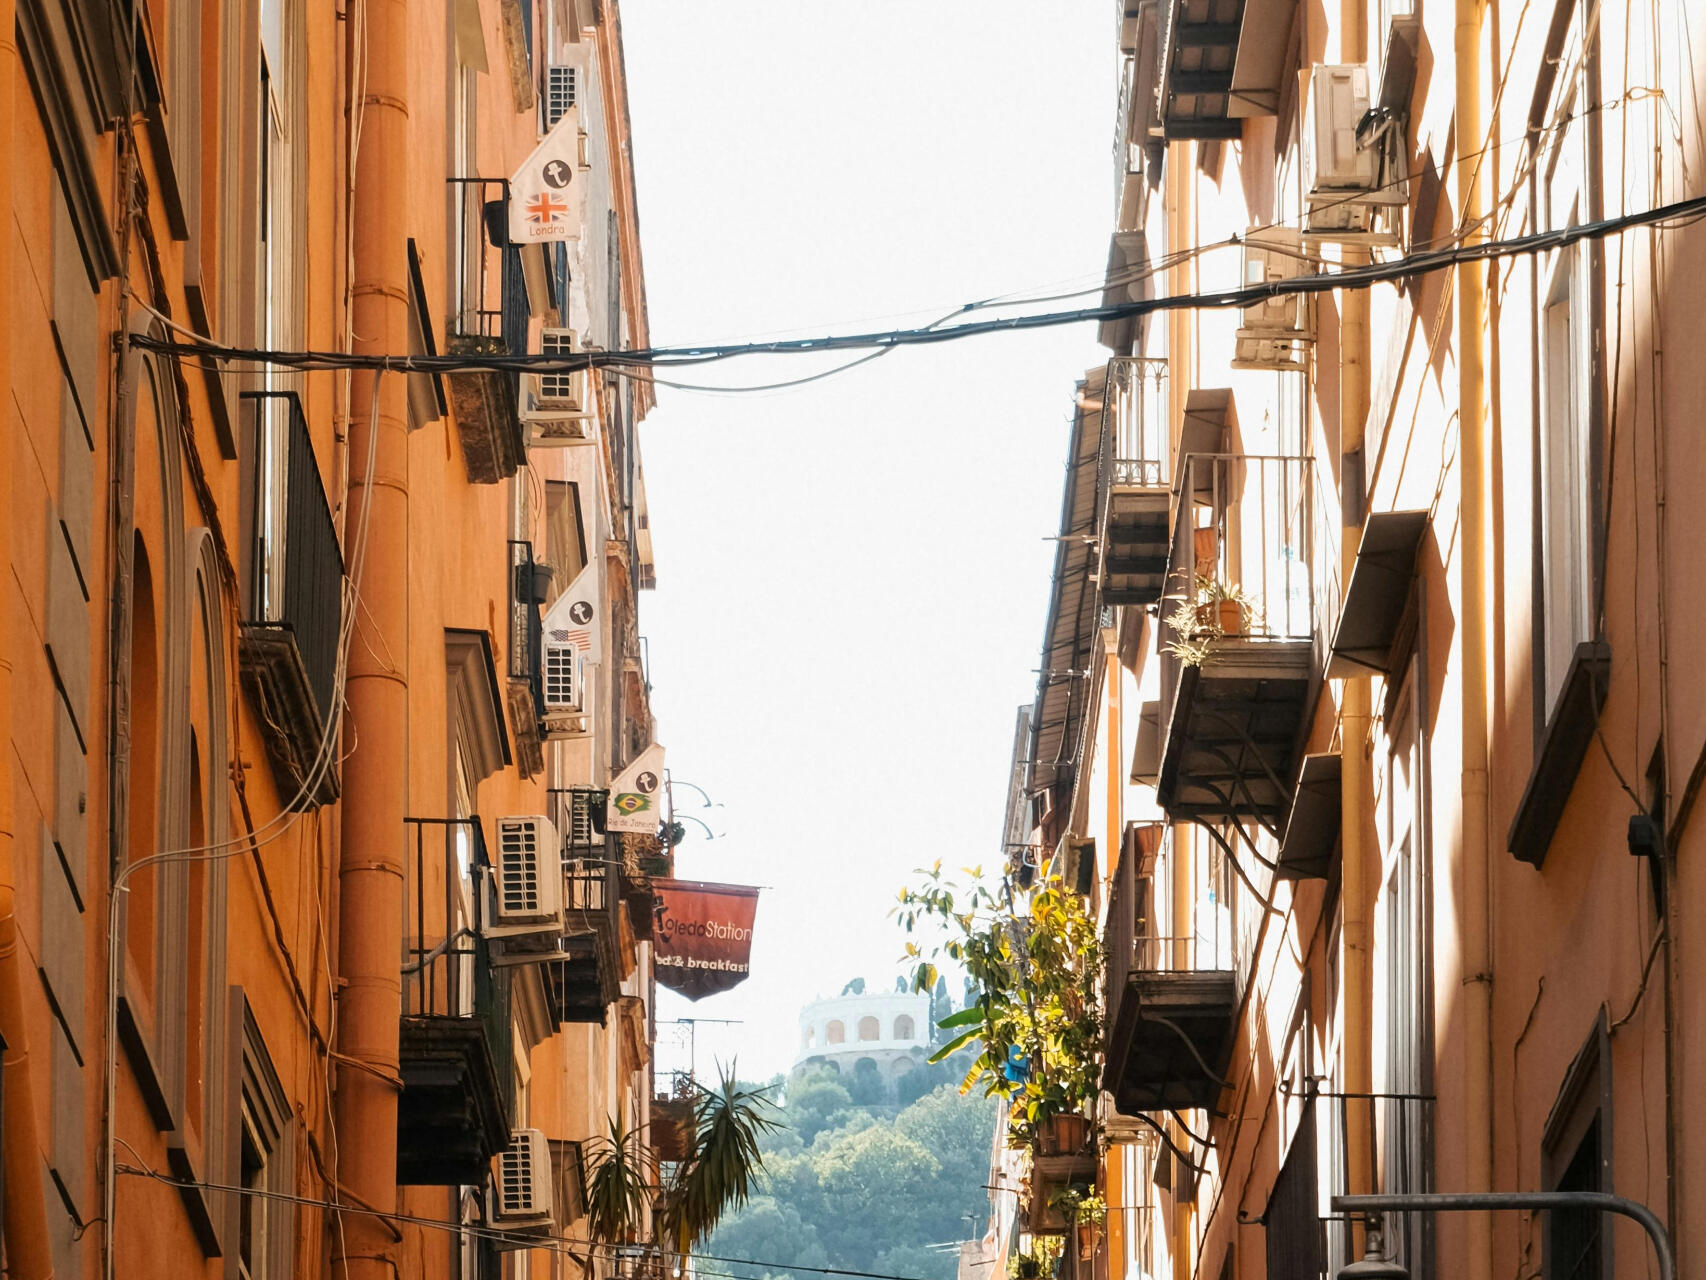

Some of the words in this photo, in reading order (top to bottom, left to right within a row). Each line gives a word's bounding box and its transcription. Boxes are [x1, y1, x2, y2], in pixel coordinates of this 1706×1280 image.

[529, 224, 565, 237] Londra
[673, 956, 684, 967] &
[687, 957, 748, 973] breakfast
